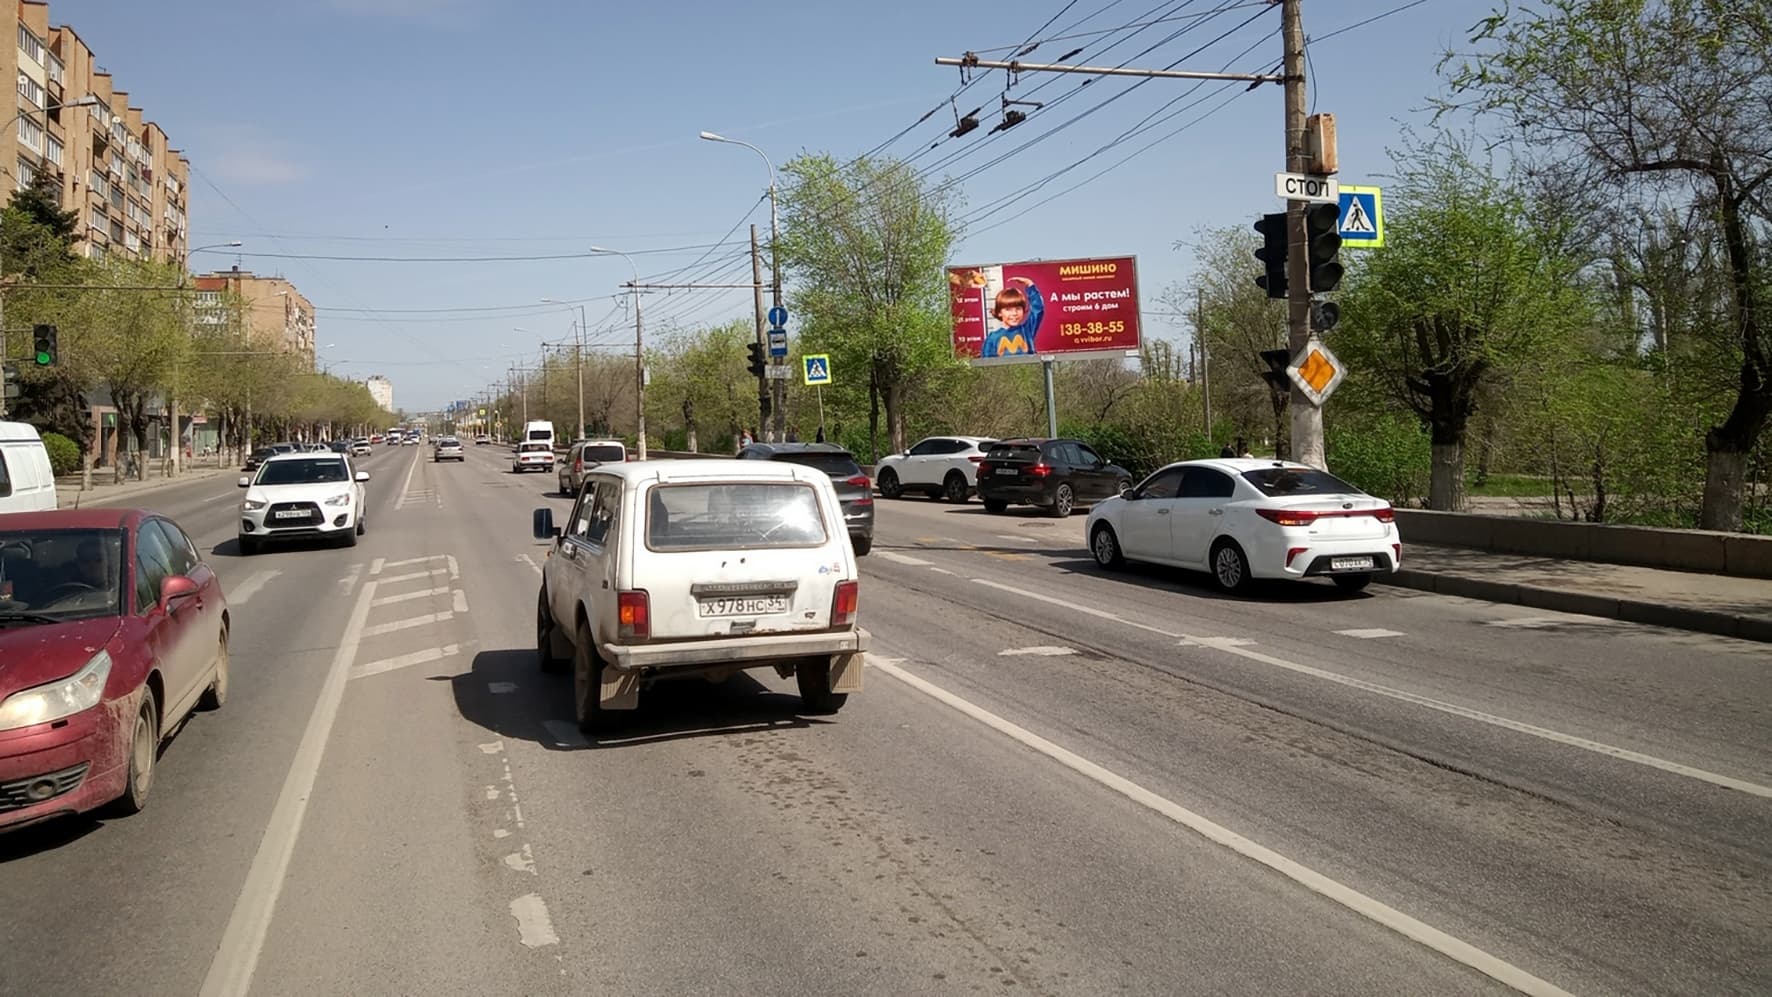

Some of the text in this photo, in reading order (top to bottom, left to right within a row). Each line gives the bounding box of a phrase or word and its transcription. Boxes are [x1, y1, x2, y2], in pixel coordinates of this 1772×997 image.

[1285, 178, 1329, 197] СТОП
[1060, 263, 1117, 275] МИШИНО
[1050, 288, 1130, 302] А мы растем!
[1063, 304, 1092, 313] строим
[1101, 303, 1119, 311] дом
[1065, 321, 1124, 335] 38-38-55
[706, 599, 764, 614] Х978НС
